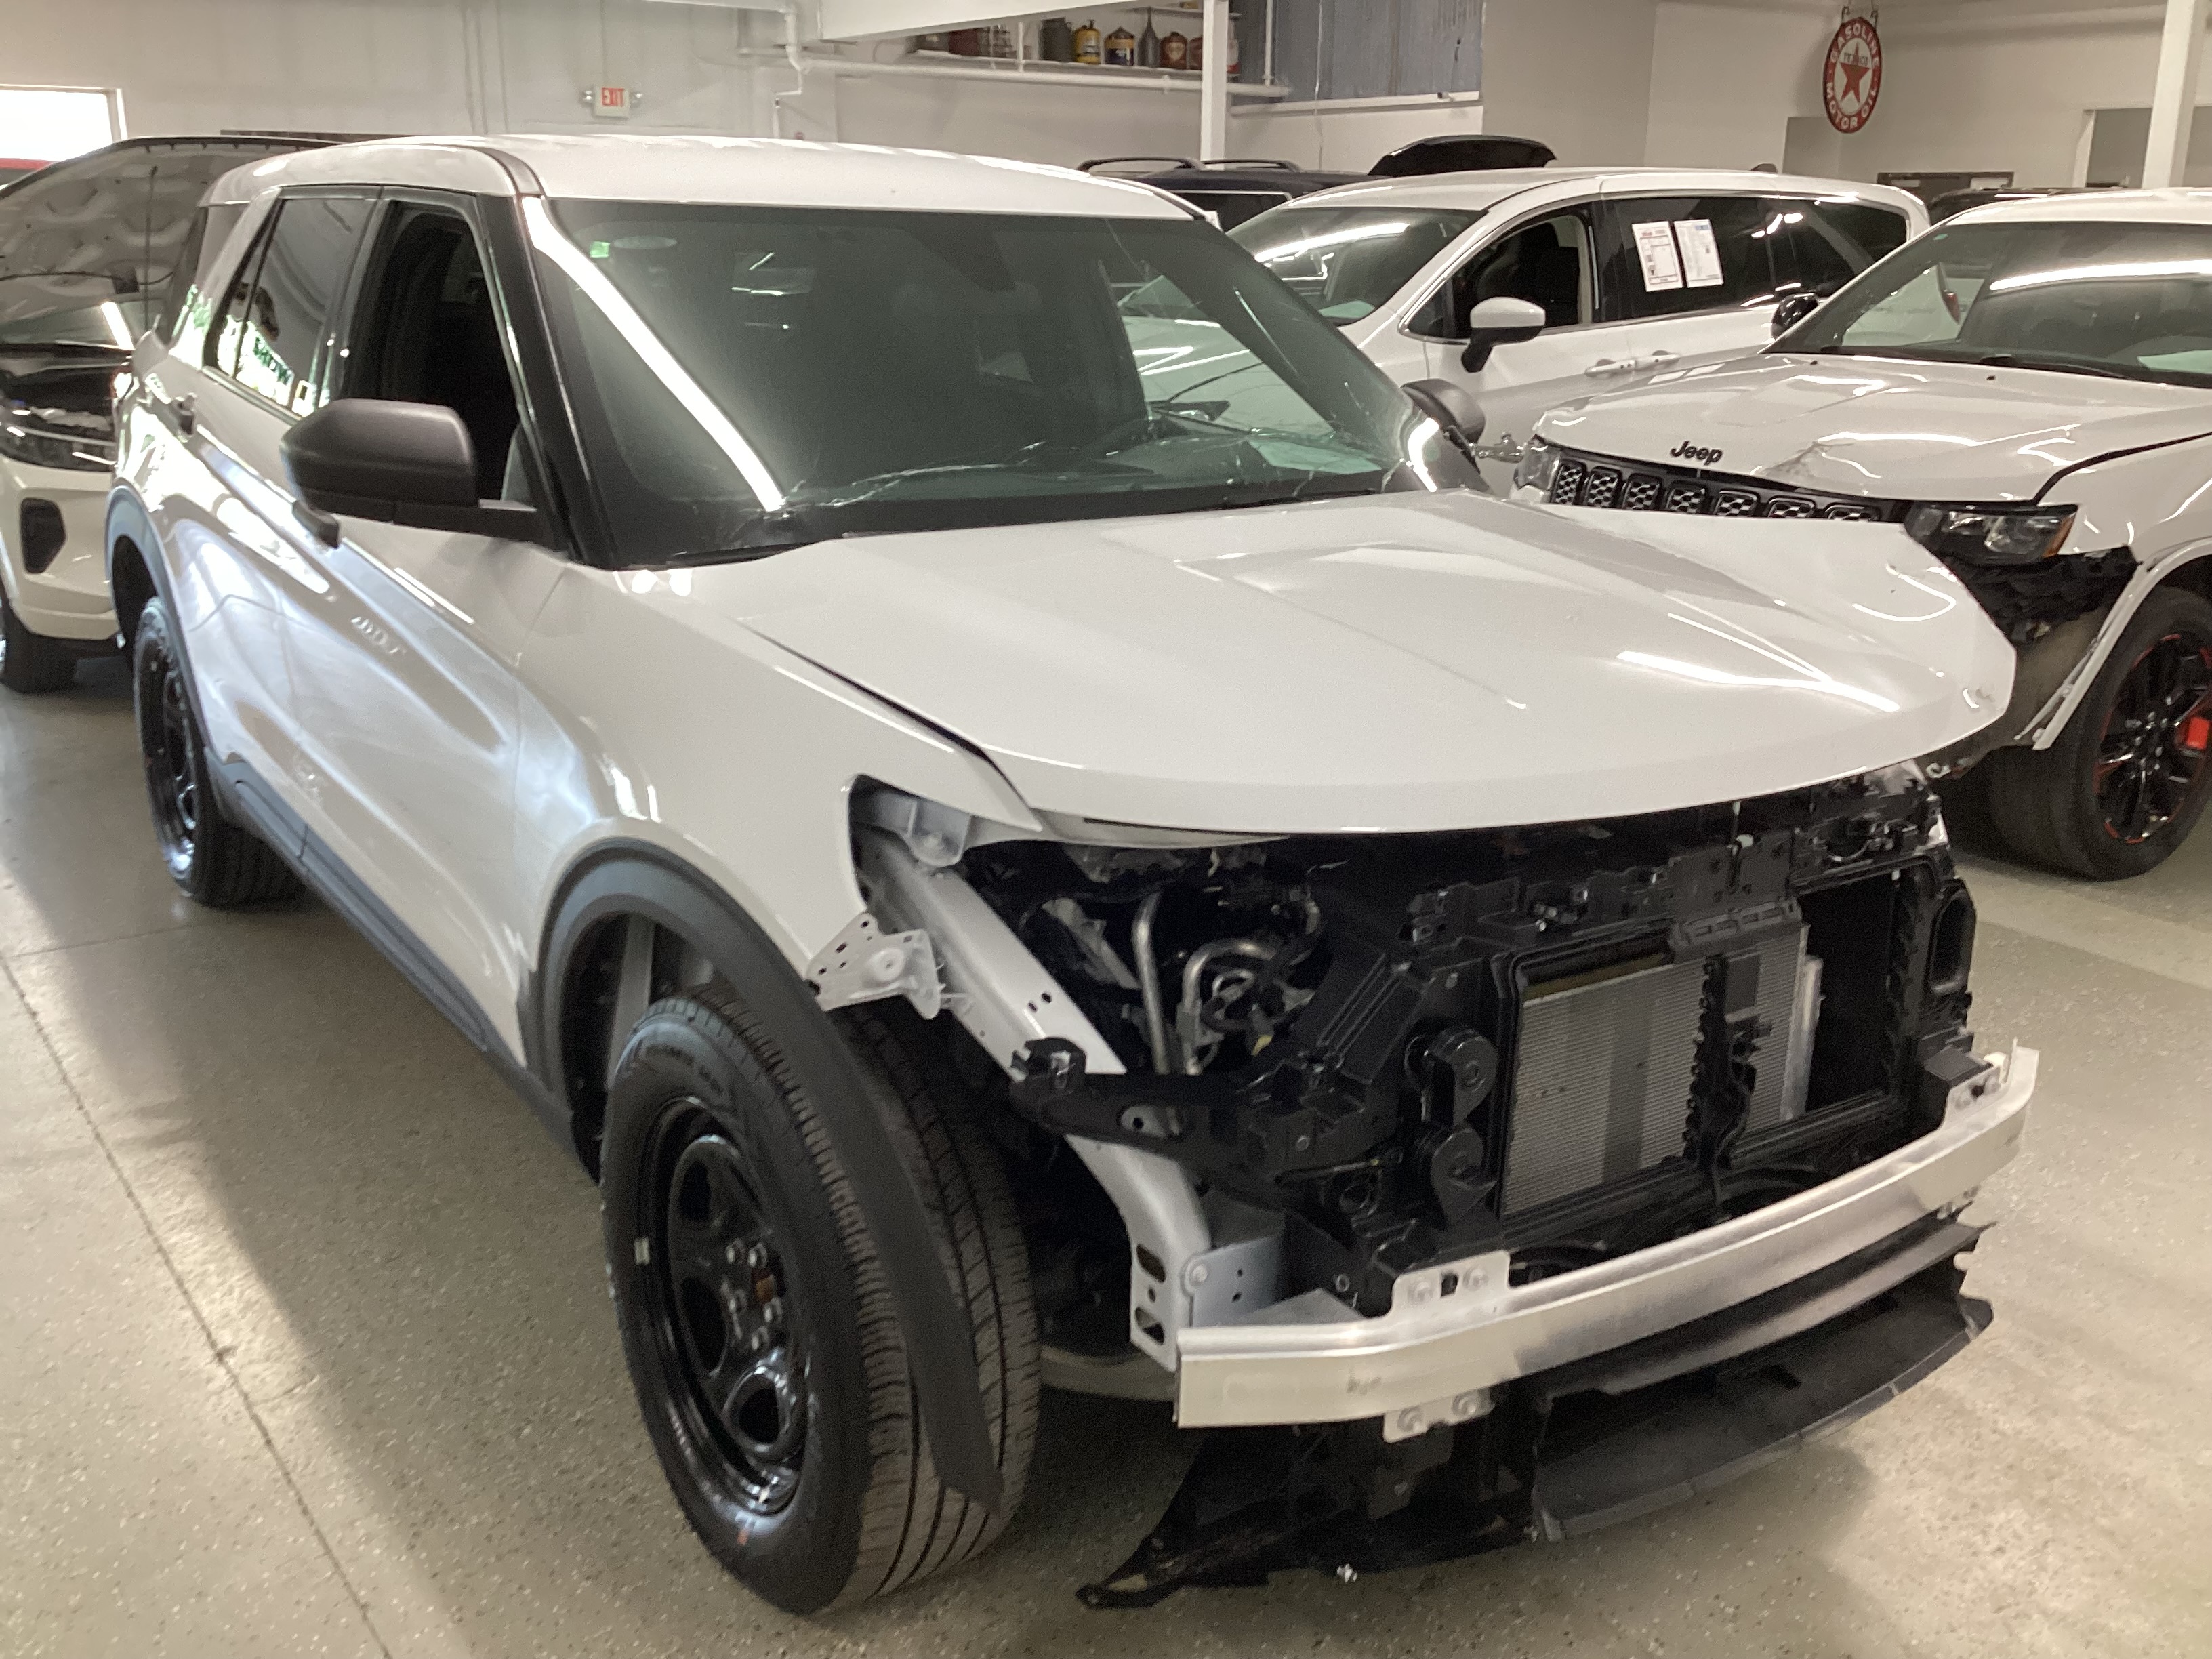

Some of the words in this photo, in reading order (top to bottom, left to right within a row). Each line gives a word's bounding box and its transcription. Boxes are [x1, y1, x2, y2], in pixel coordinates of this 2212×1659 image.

[601, 87, 624, 107] EXIT
[1826, 82, 1858, 129] MOTOR
[1861, 87, 1877, 117] OIL
[1671, 441, 1723, 466] Jeep
